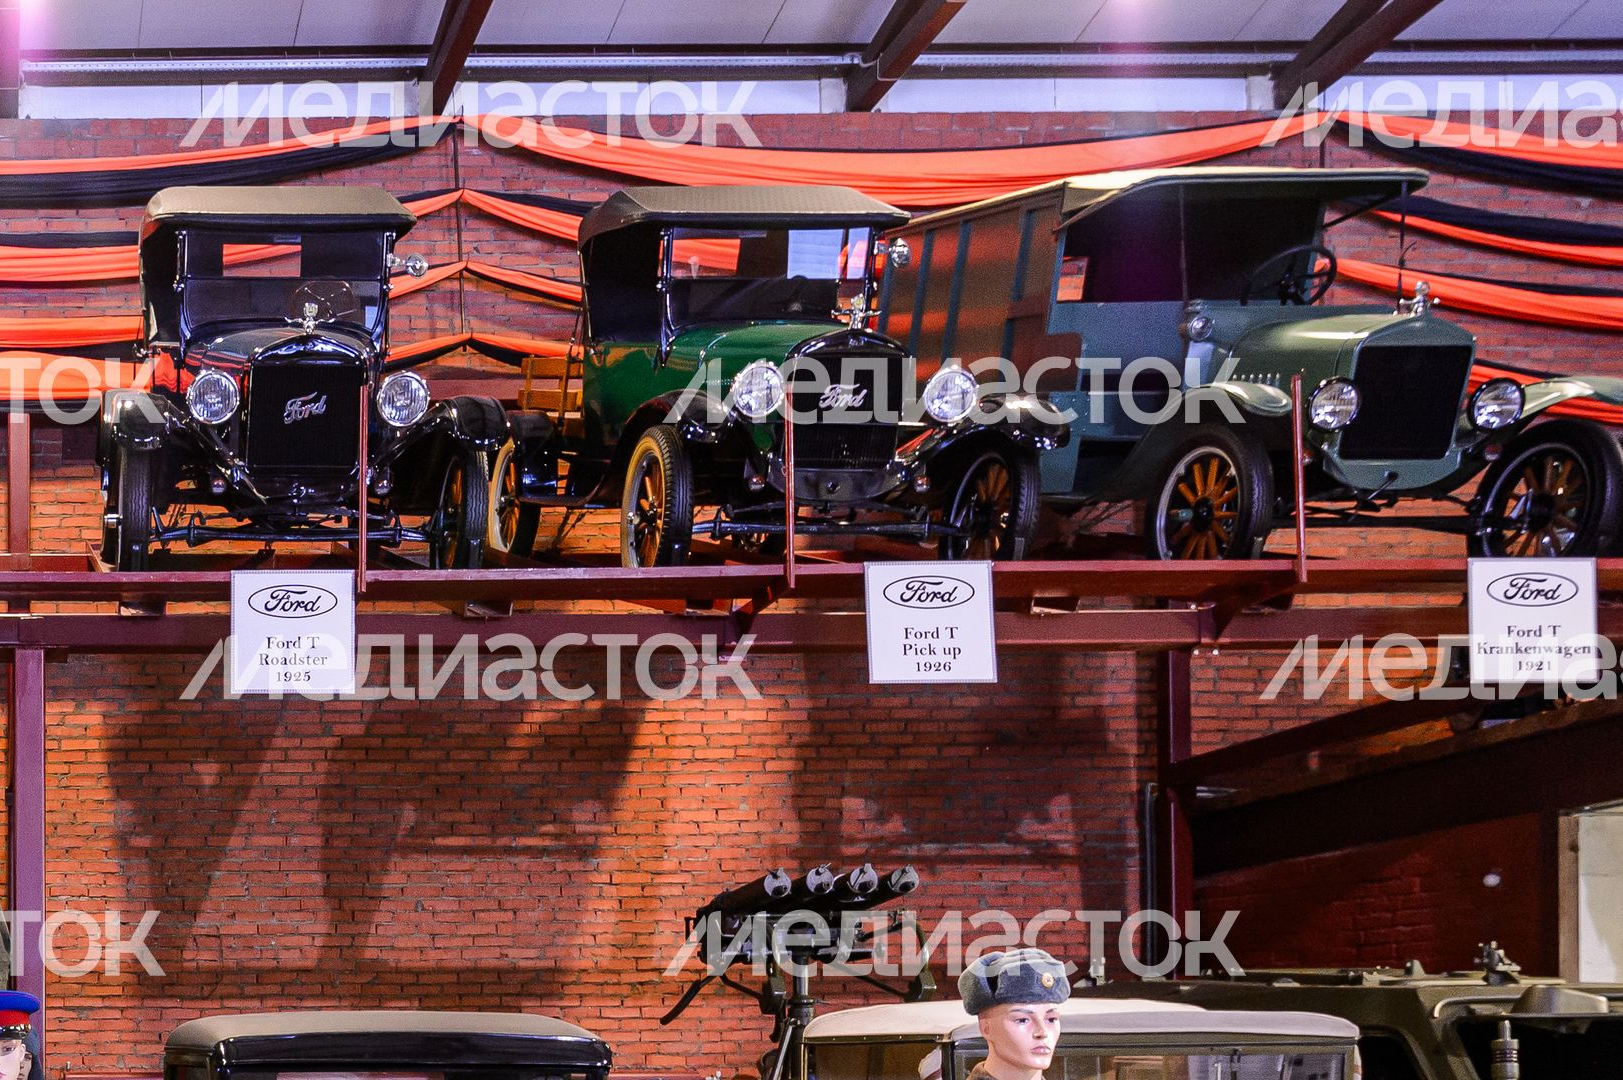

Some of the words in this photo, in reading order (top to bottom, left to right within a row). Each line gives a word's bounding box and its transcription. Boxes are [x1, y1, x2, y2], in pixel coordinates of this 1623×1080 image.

[818, 383, 868, 408] Ford
[283, 391, 327, 424] Ford
[899, 579, 958, 603] Ford
[1503, 577, 1562, 601] Ford
[264, 588, 322, 612] Ford
[904, 626, 940, 640] Ford
[944, 626, 959, 639] T
[1507, 624, 1543, 638] Ford
[1547, 624, 1562, 637] T
[266, 636, 301, 650] Ford
[306, 636, 320, 649] T
[1477, 641, 1592, 658] Krankenwagen
[259, 652, 328, 666] Roadster
[903, 643, 937, 657] Pick
[943, 646, 962, 660] up
[916, 661, 952, 673] 1926
[1518, 660, 1552, 672] 1921
[276, 670, 312, 683] 1925
